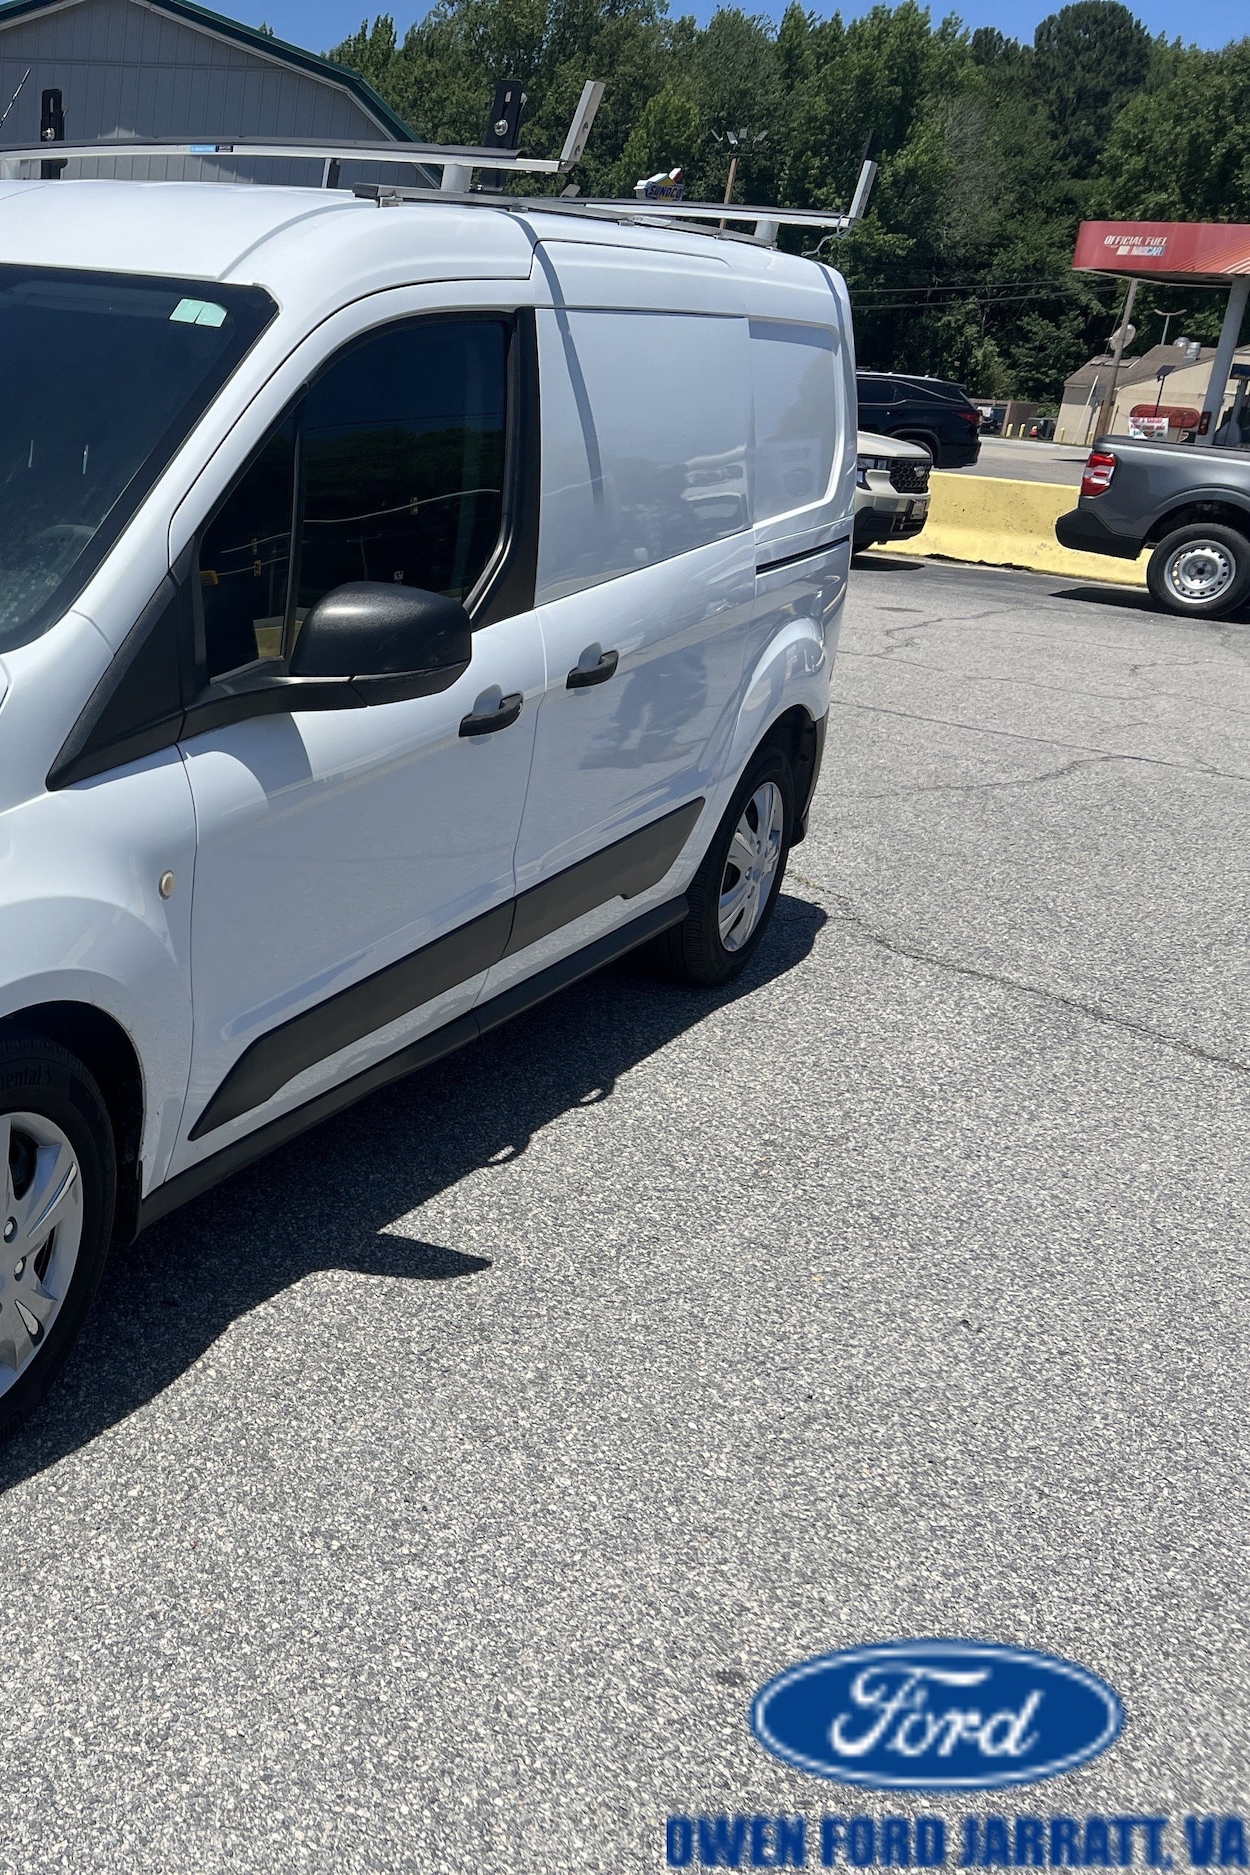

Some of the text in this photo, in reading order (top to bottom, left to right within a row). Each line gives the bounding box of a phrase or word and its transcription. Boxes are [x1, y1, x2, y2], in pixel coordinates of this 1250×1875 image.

[649, 185, 683, 199] SUNOCO
[1104, 235, 1167, 246] OFFICIAL FUEL
